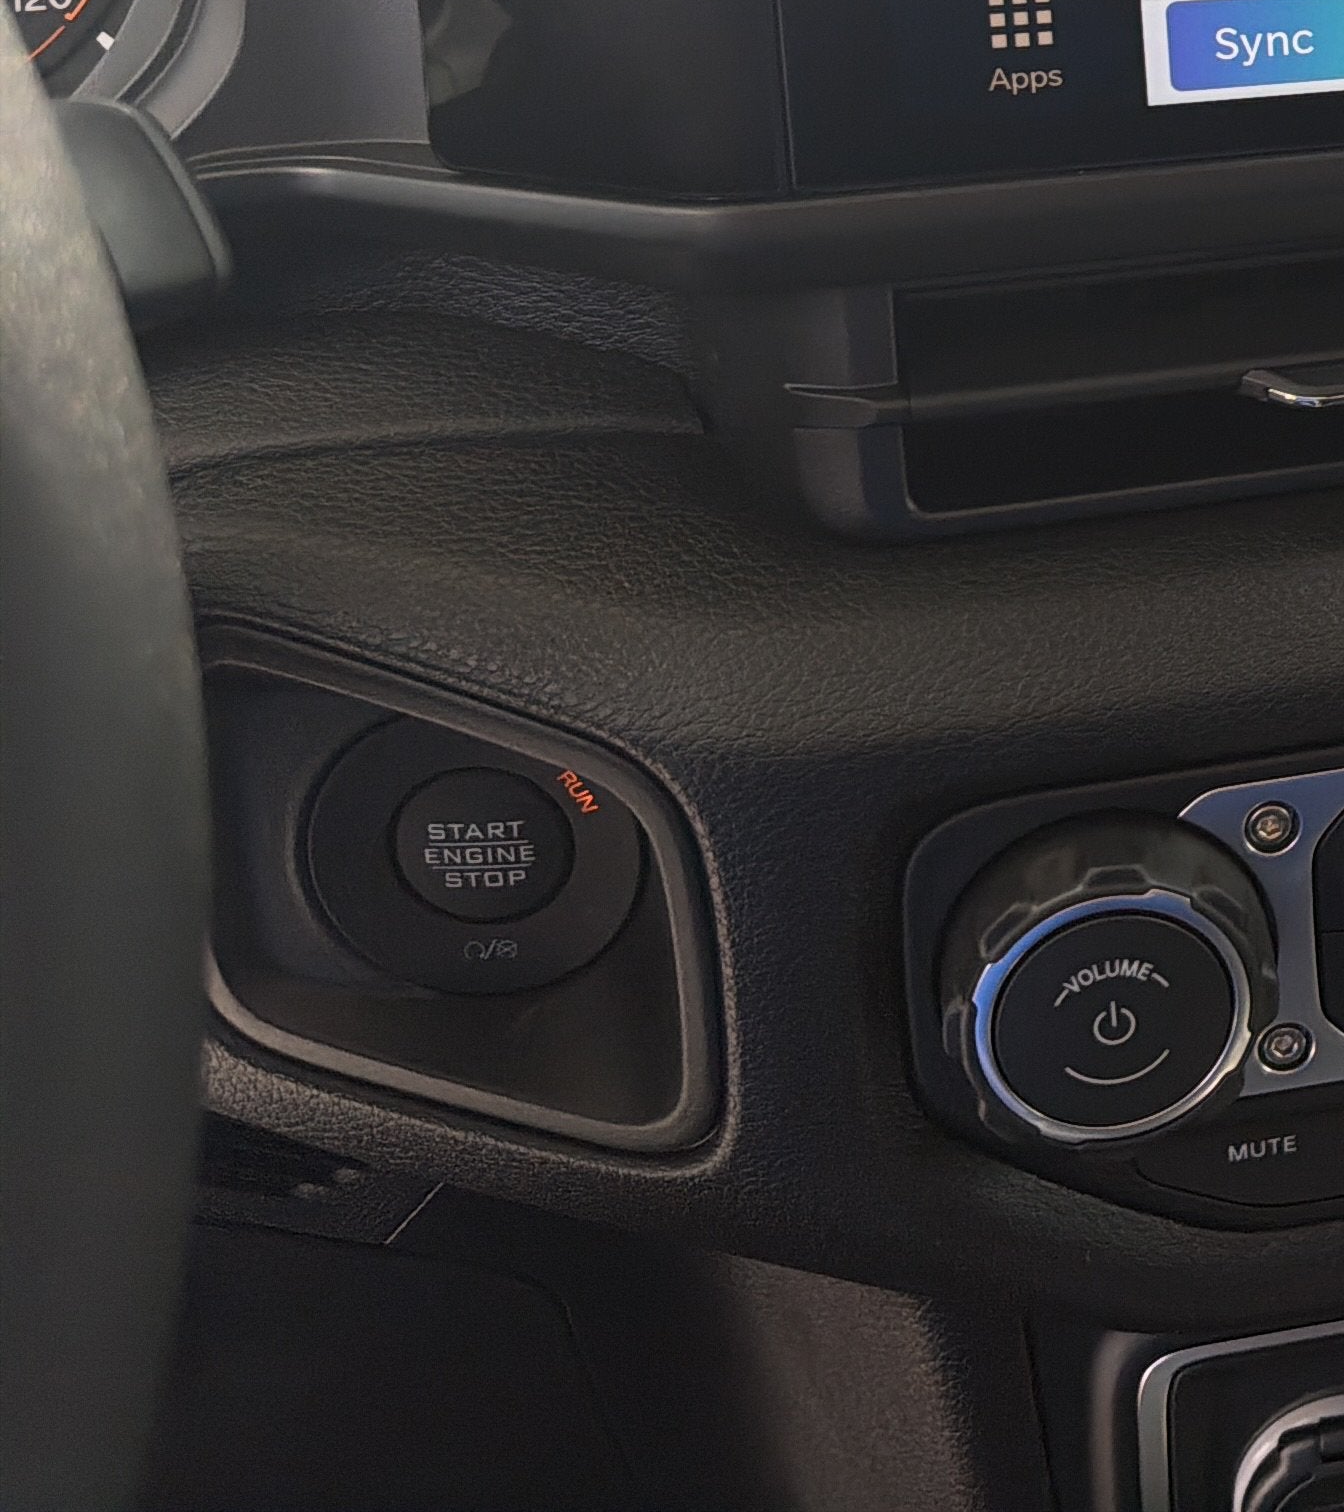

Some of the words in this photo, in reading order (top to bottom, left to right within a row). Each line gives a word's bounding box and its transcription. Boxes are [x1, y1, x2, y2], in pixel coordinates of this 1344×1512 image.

[1214, 25, 1315, 68] Sync
[987, 67, 1064, 96] Apps
[556, 768, 600, 816] RUN
[427, 820, 525, 842] START
[423, 843, 537, 866] ENGINE
[444, 868, 527, 890] STOP
[1061, 957, 1155, 996] VOLUME
[1227, 1133, 1299, 1163] MUTE
